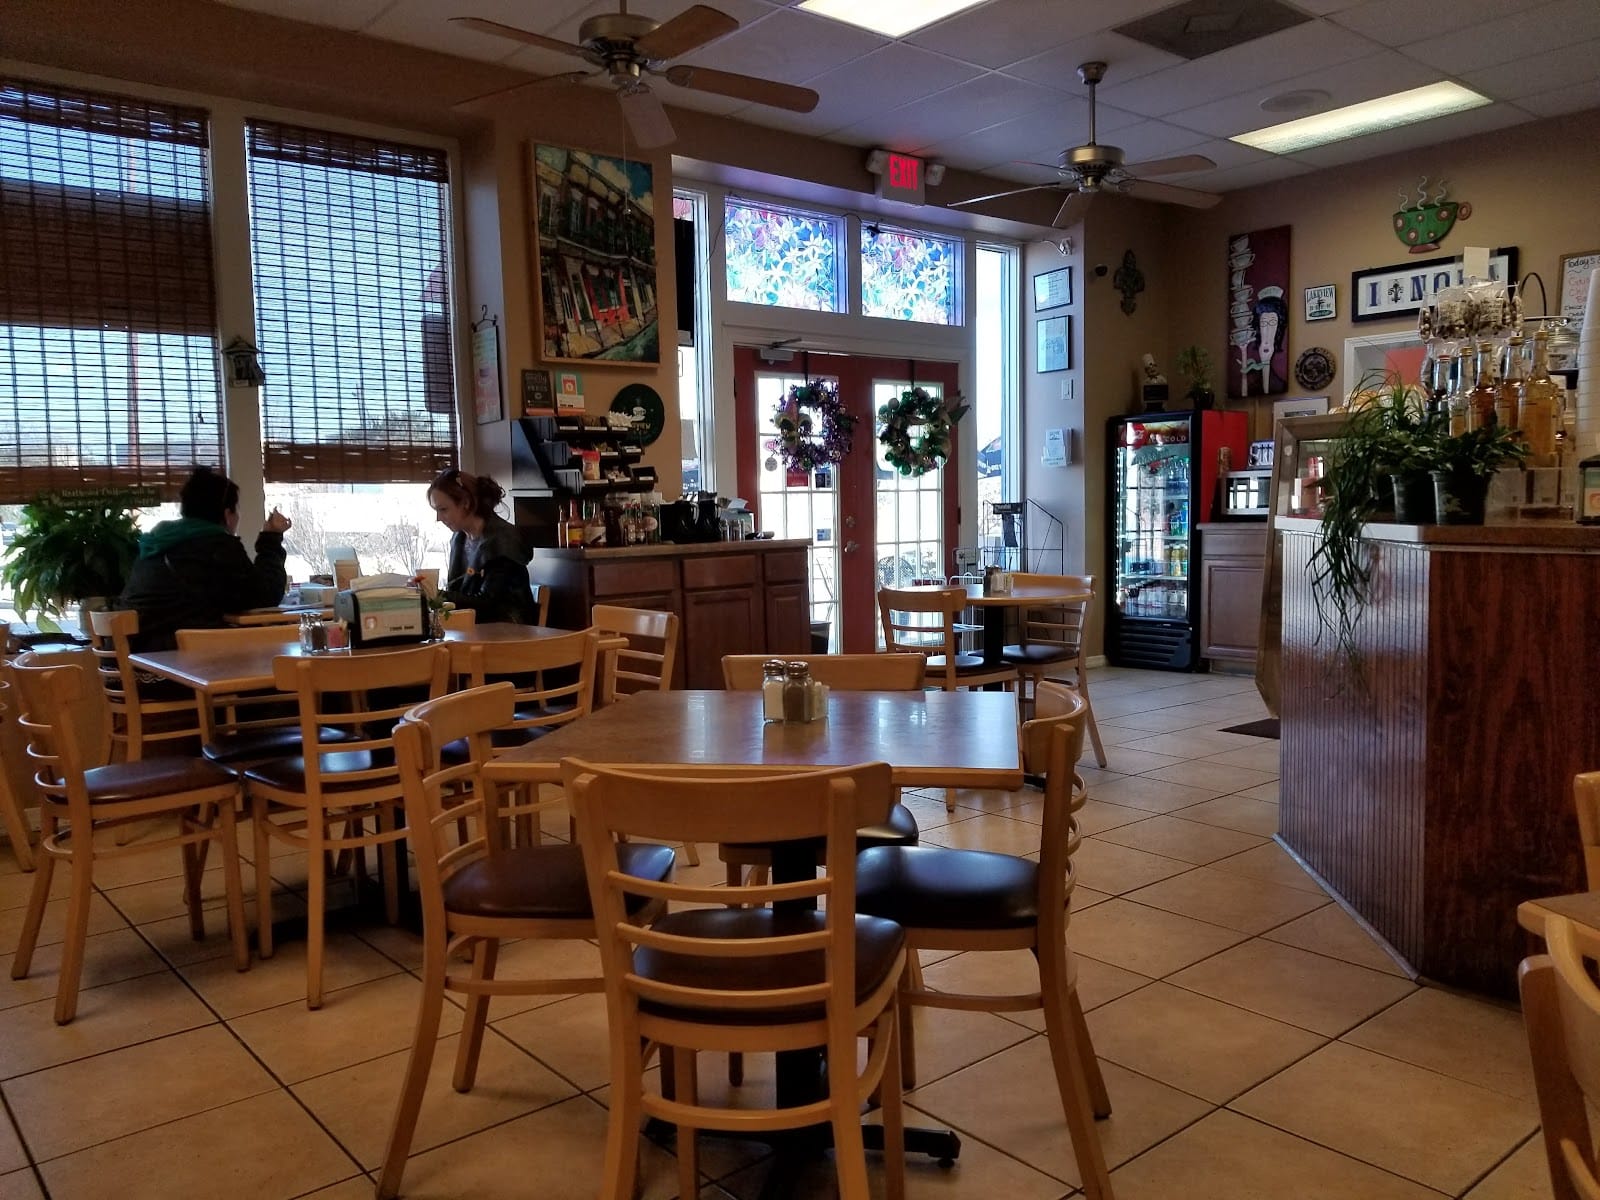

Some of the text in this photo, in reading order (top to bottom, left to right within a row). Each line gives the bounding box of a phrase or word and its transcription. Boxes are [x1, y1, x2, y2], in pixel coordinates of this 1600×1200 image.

[889, 154, 918, 191] EXIT
[1307, 287, 1334, 304] LAKEVIEW
[1368, 283, 1378, 306] I
